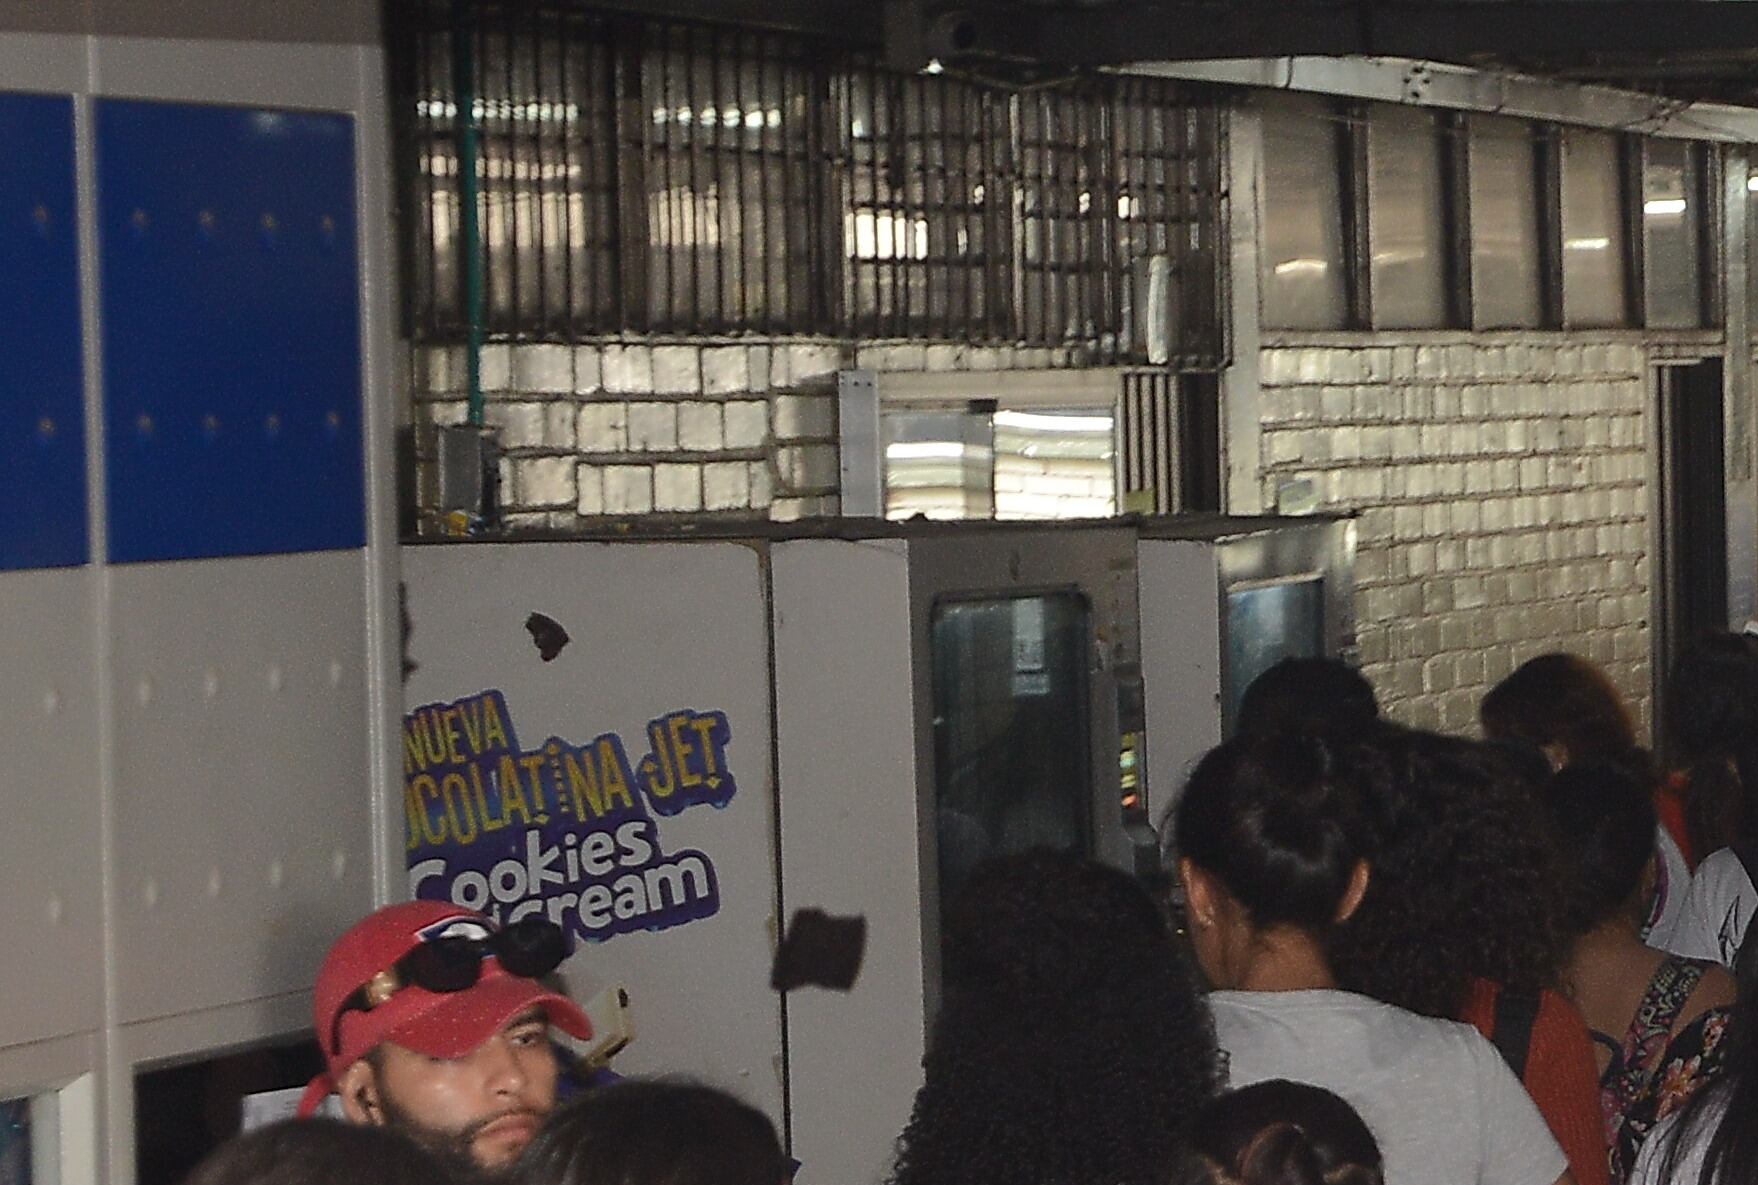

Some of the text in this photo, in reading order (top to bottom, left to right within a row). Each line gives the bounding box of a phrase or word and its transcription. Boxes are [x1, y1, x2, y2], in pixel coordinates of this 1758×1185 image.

[403, 695, 508, 773] NUEVA
[642, 716, 721, 798] JET
[408, 821, 652, 912] Cookies
